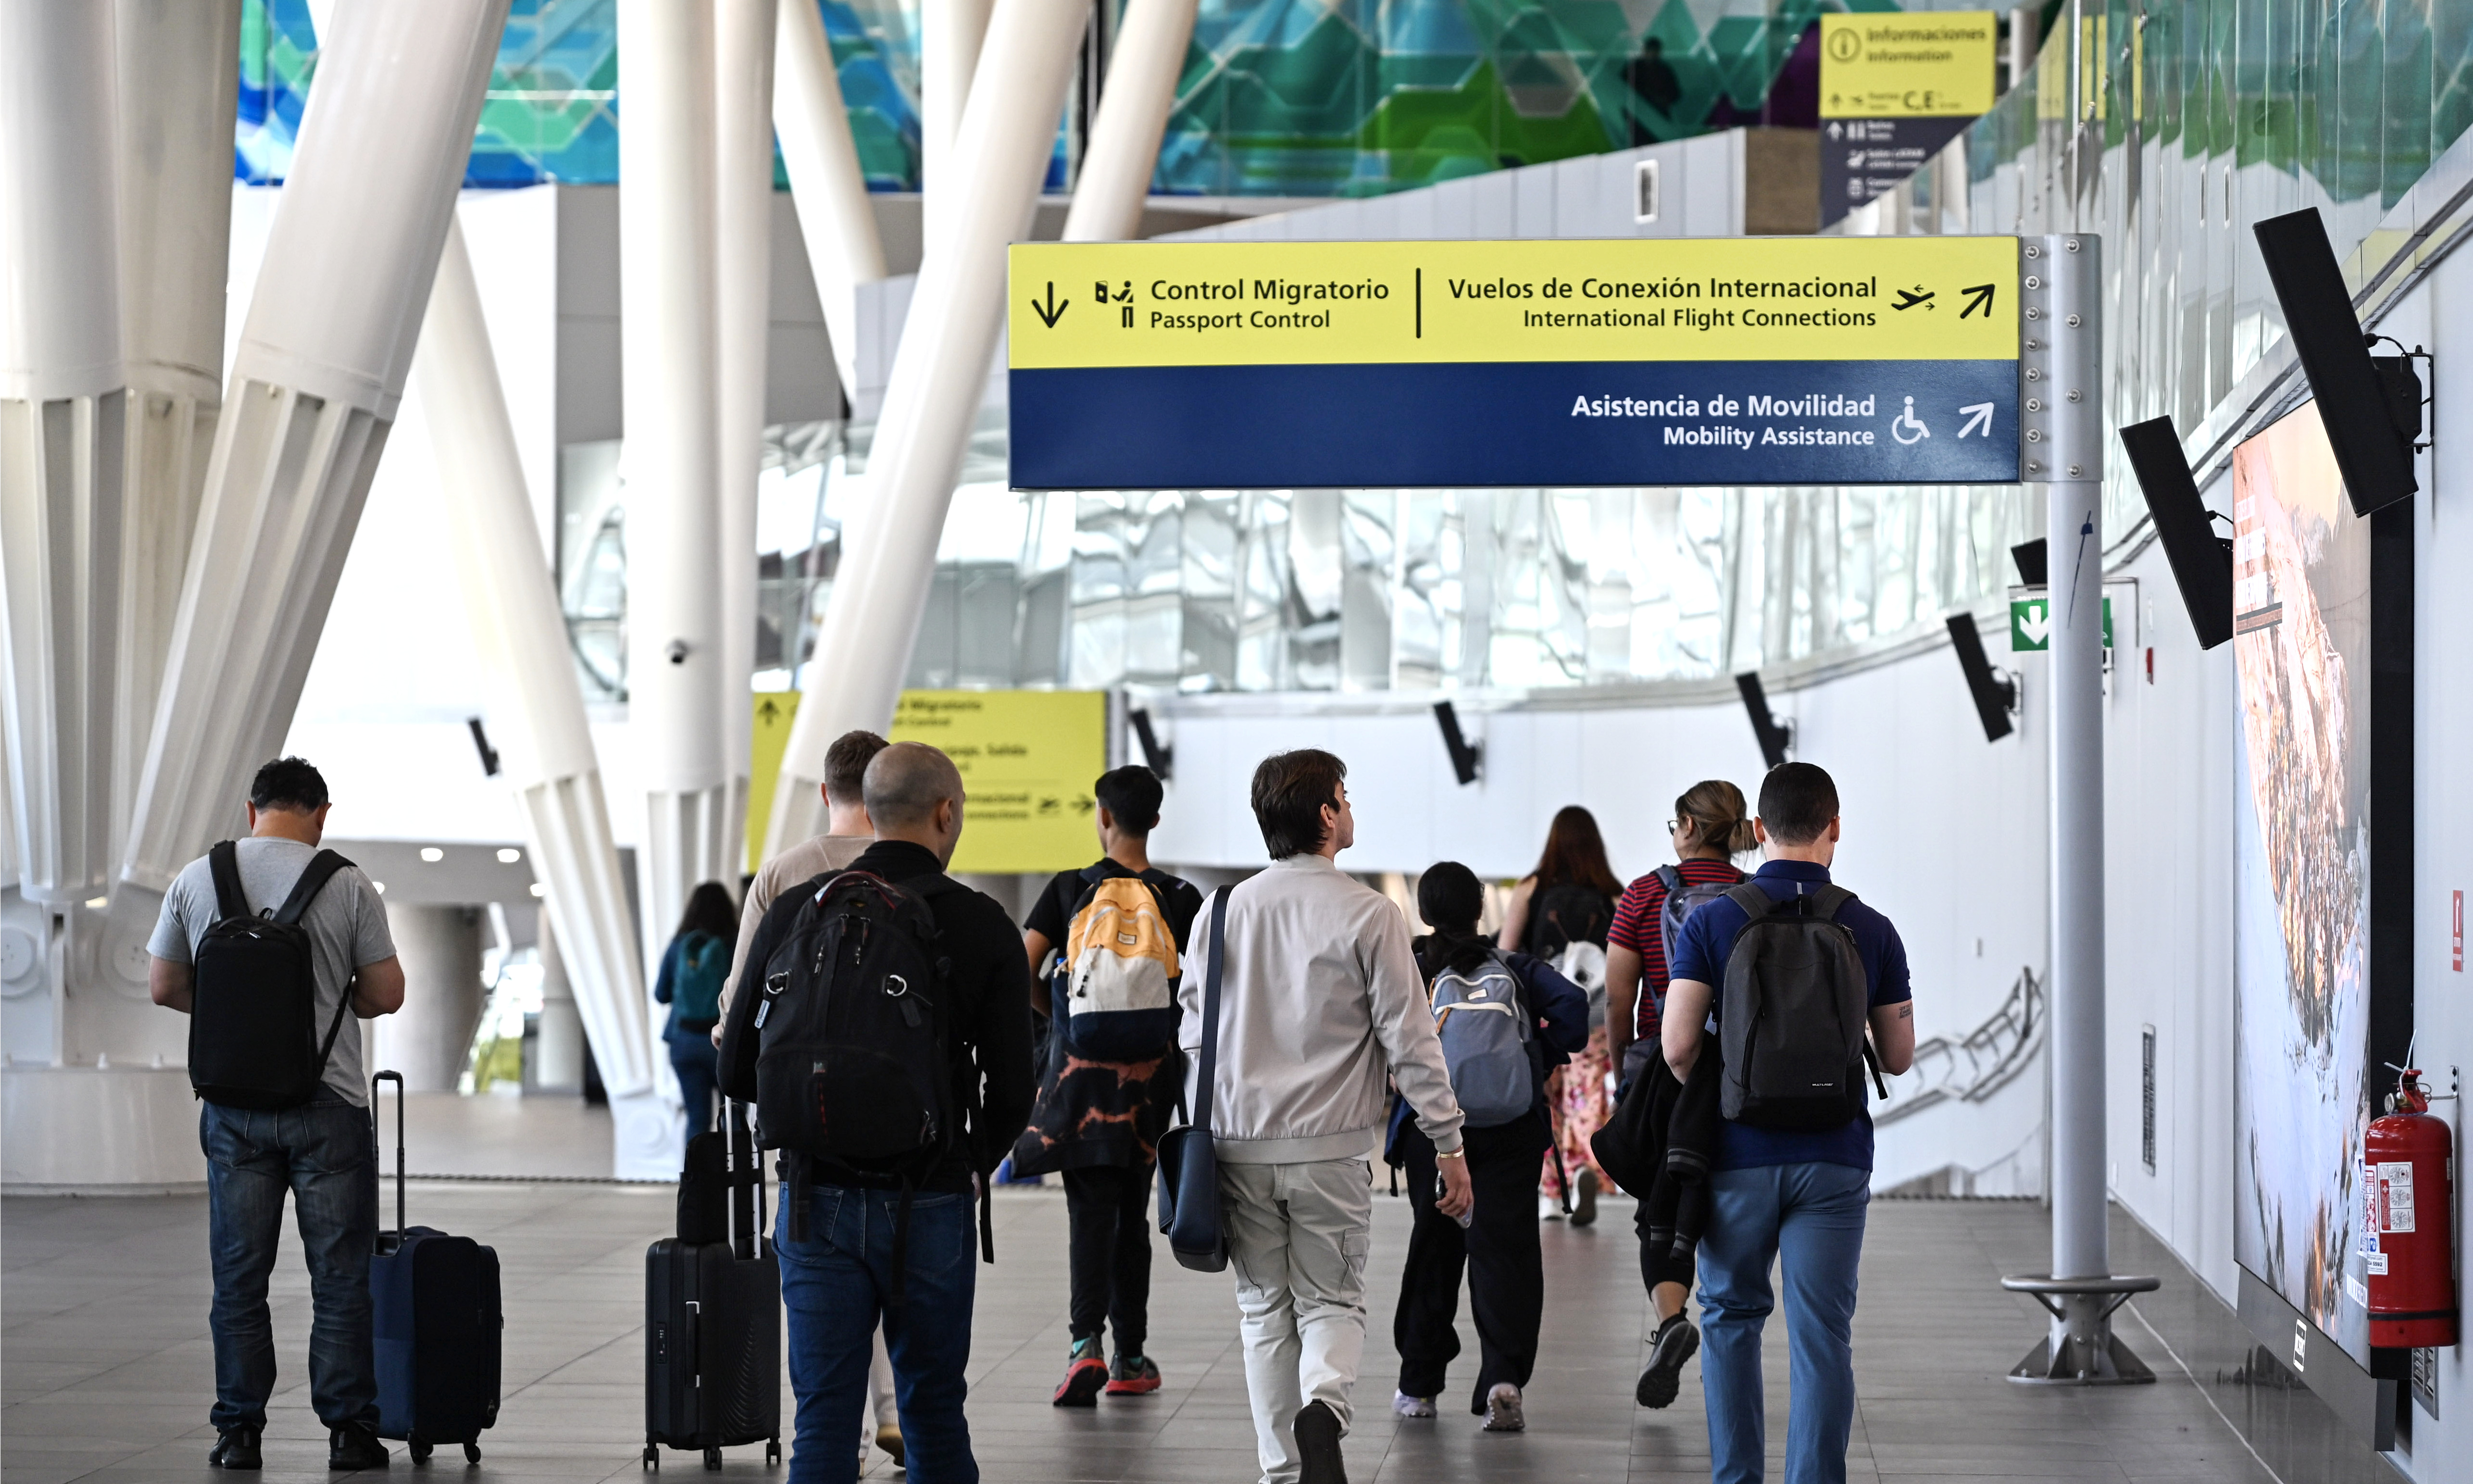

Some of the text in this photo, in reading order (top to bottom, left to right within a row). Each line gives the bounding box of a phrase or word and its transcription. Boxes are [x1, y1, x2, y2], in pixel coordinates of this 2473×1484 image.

[1150, 278, 1389, 305] Control Migratorio
[1448, 276, 1876, 299] Vuelos de Conexión Internacional
[1150, 309, 1330, 333] Passport Control
[1524, 308, 1876, 331] International Flight Connections
[1571, 394, 1875, 416] Asistencia de Movilidad
[1663, 425, 1875, 449] Mobility Assistance
